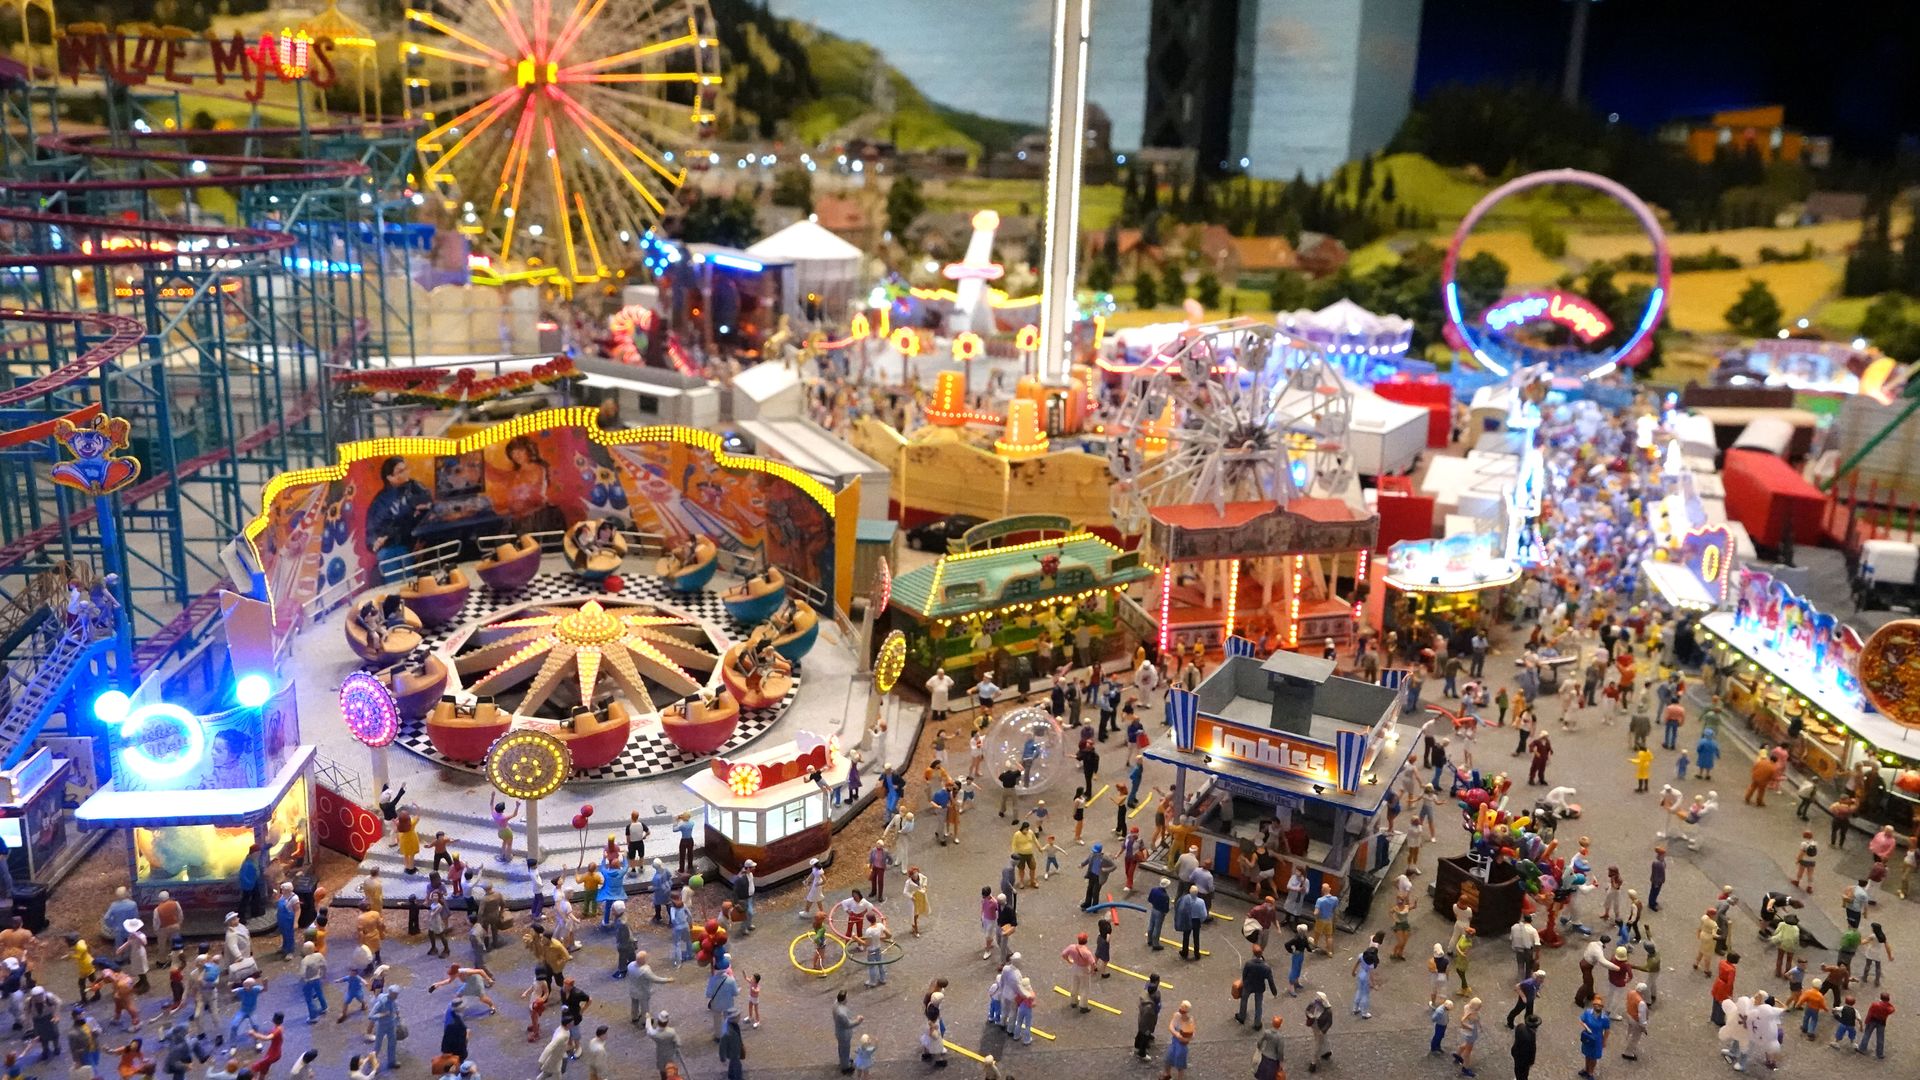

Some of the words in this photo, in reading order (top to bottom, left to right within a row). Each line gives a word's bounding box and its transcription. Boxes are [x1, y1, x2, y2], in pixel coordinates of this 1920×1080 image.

[55, 23, 193, 86] WILDE
[205, 27, 335, 101] MAUS
[1212, 726, 1327, 777] Imbiss
